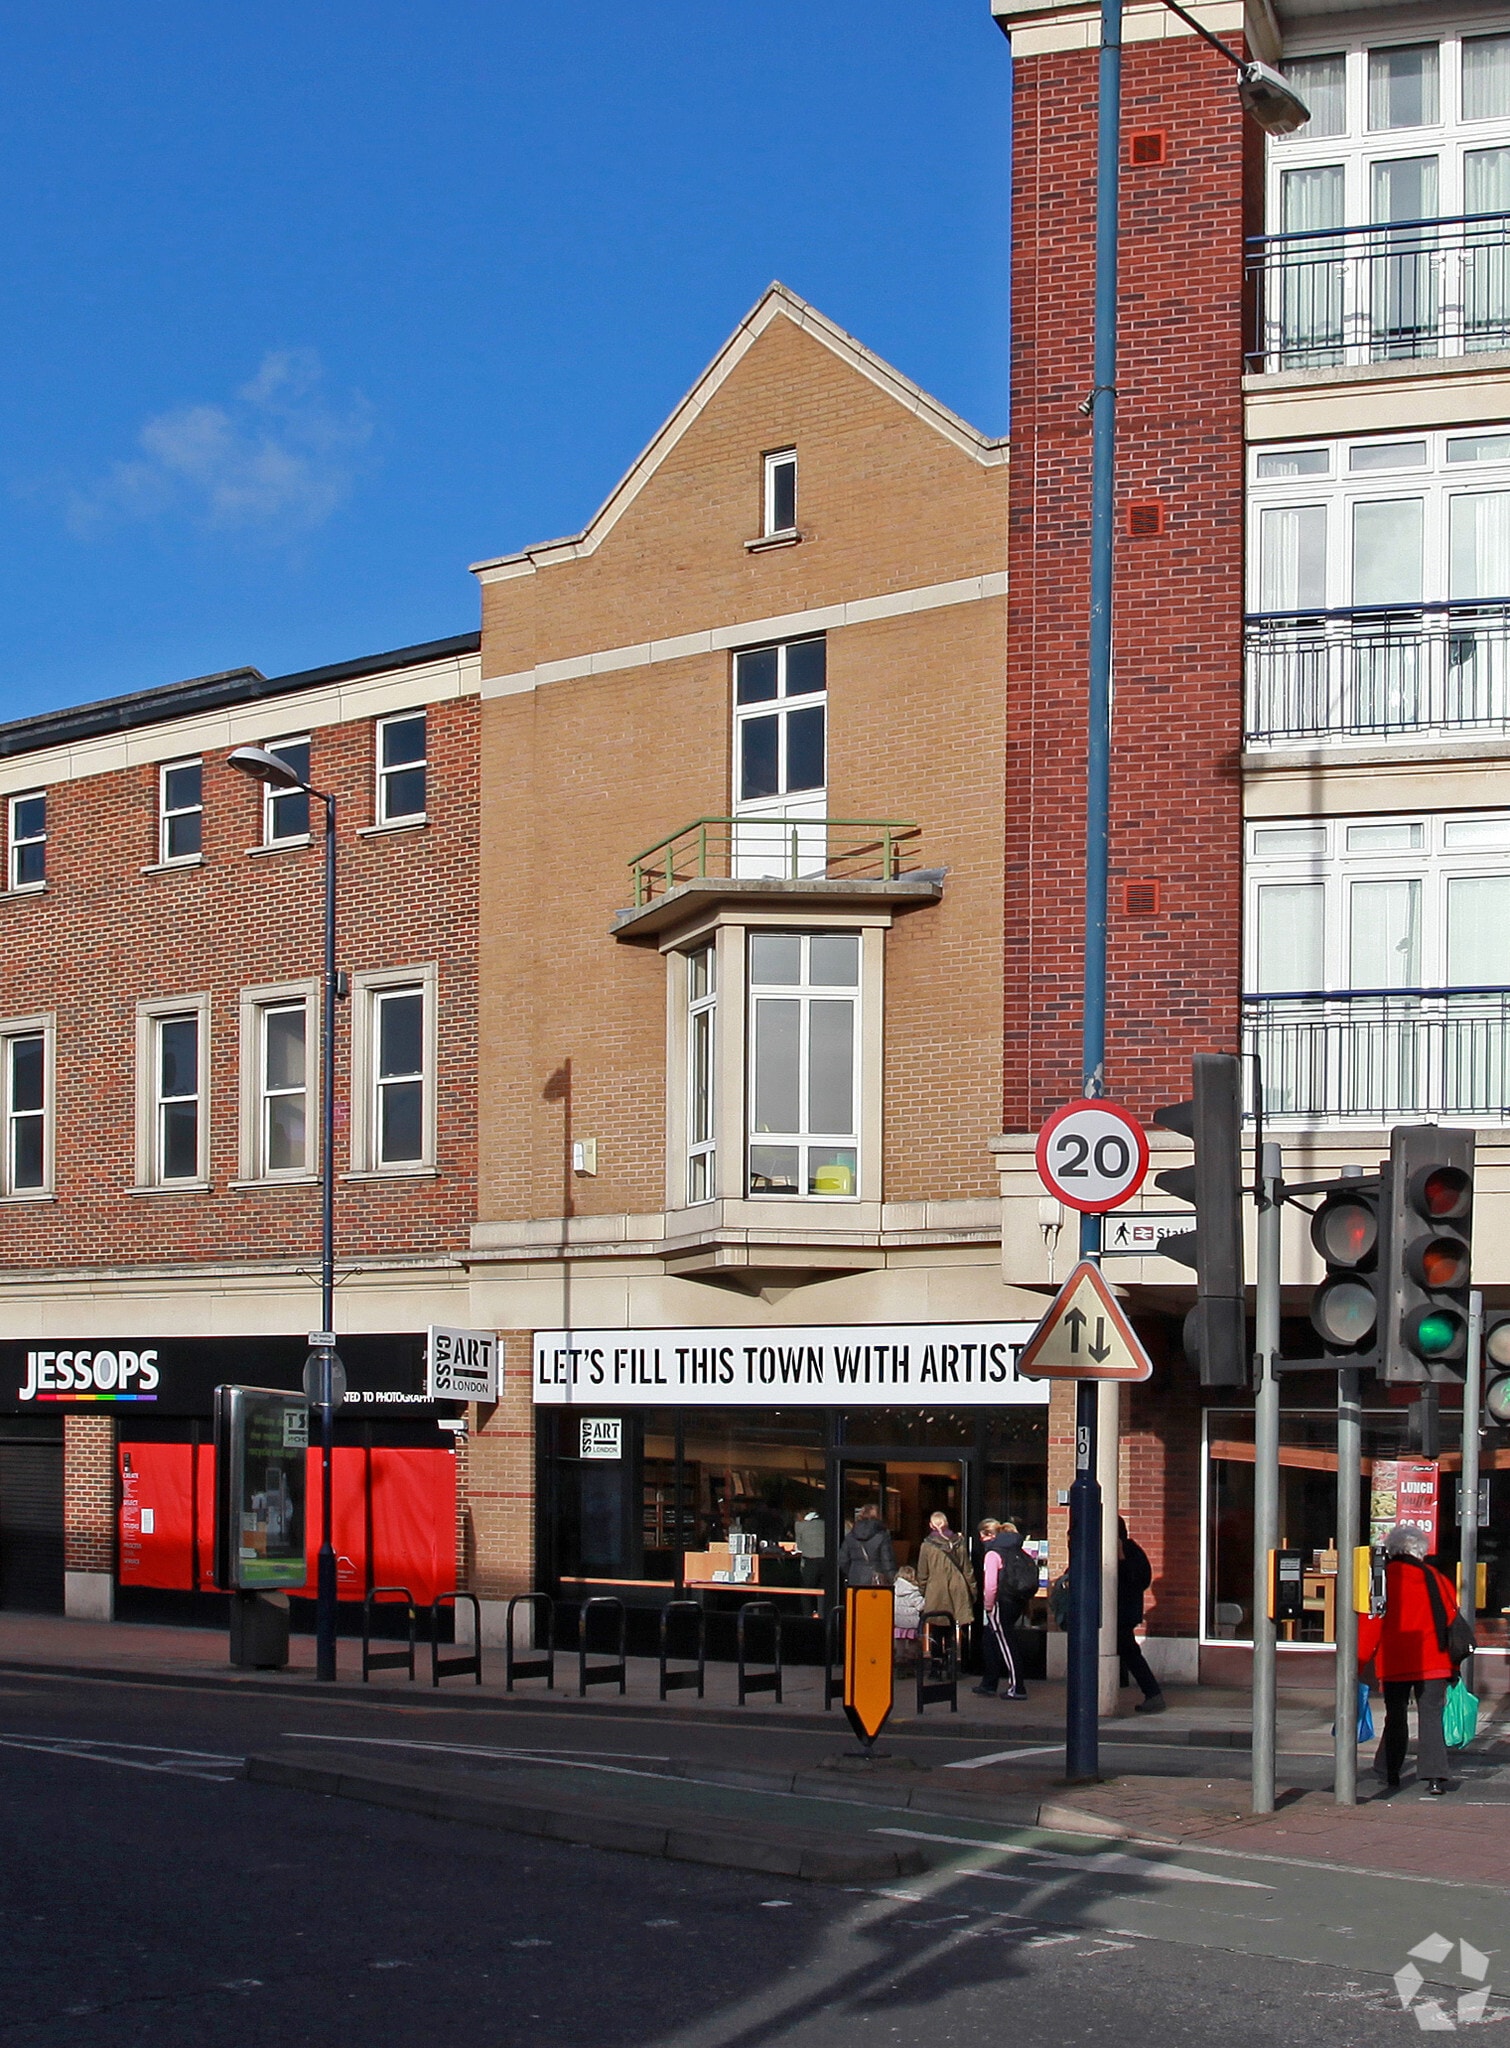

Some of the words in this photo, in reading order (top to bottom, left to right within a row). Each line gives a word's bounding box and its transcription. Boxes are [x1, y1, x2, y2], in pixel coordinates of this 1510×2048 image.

[1056, 1134, 1130, 1178] 20
[436, 1335, 451, 1389] CASS
[453, 1337, 492, 1367] ART
[539, 1349, 605, 1384] LET'S
[614, 1348, 667, 1384] FILL
[675, 1347, 734, 1384] THIS
[743, 1346, 824, 1384] TOWN
[833, 1344, 909, 1383] WITH
[919, 1343, 1043, 1382] ARTIST
[18, 1350, 160, 1400] JESSOPS
[452, 1380, 489, 1393] LONDON
[363, 1391, 375, 1403] TO
[582, 1422, 592, 1453] CASS
[593, 1422, 620, 1438] ART
[1400, 1481, 1434, 1494] LUNCH
